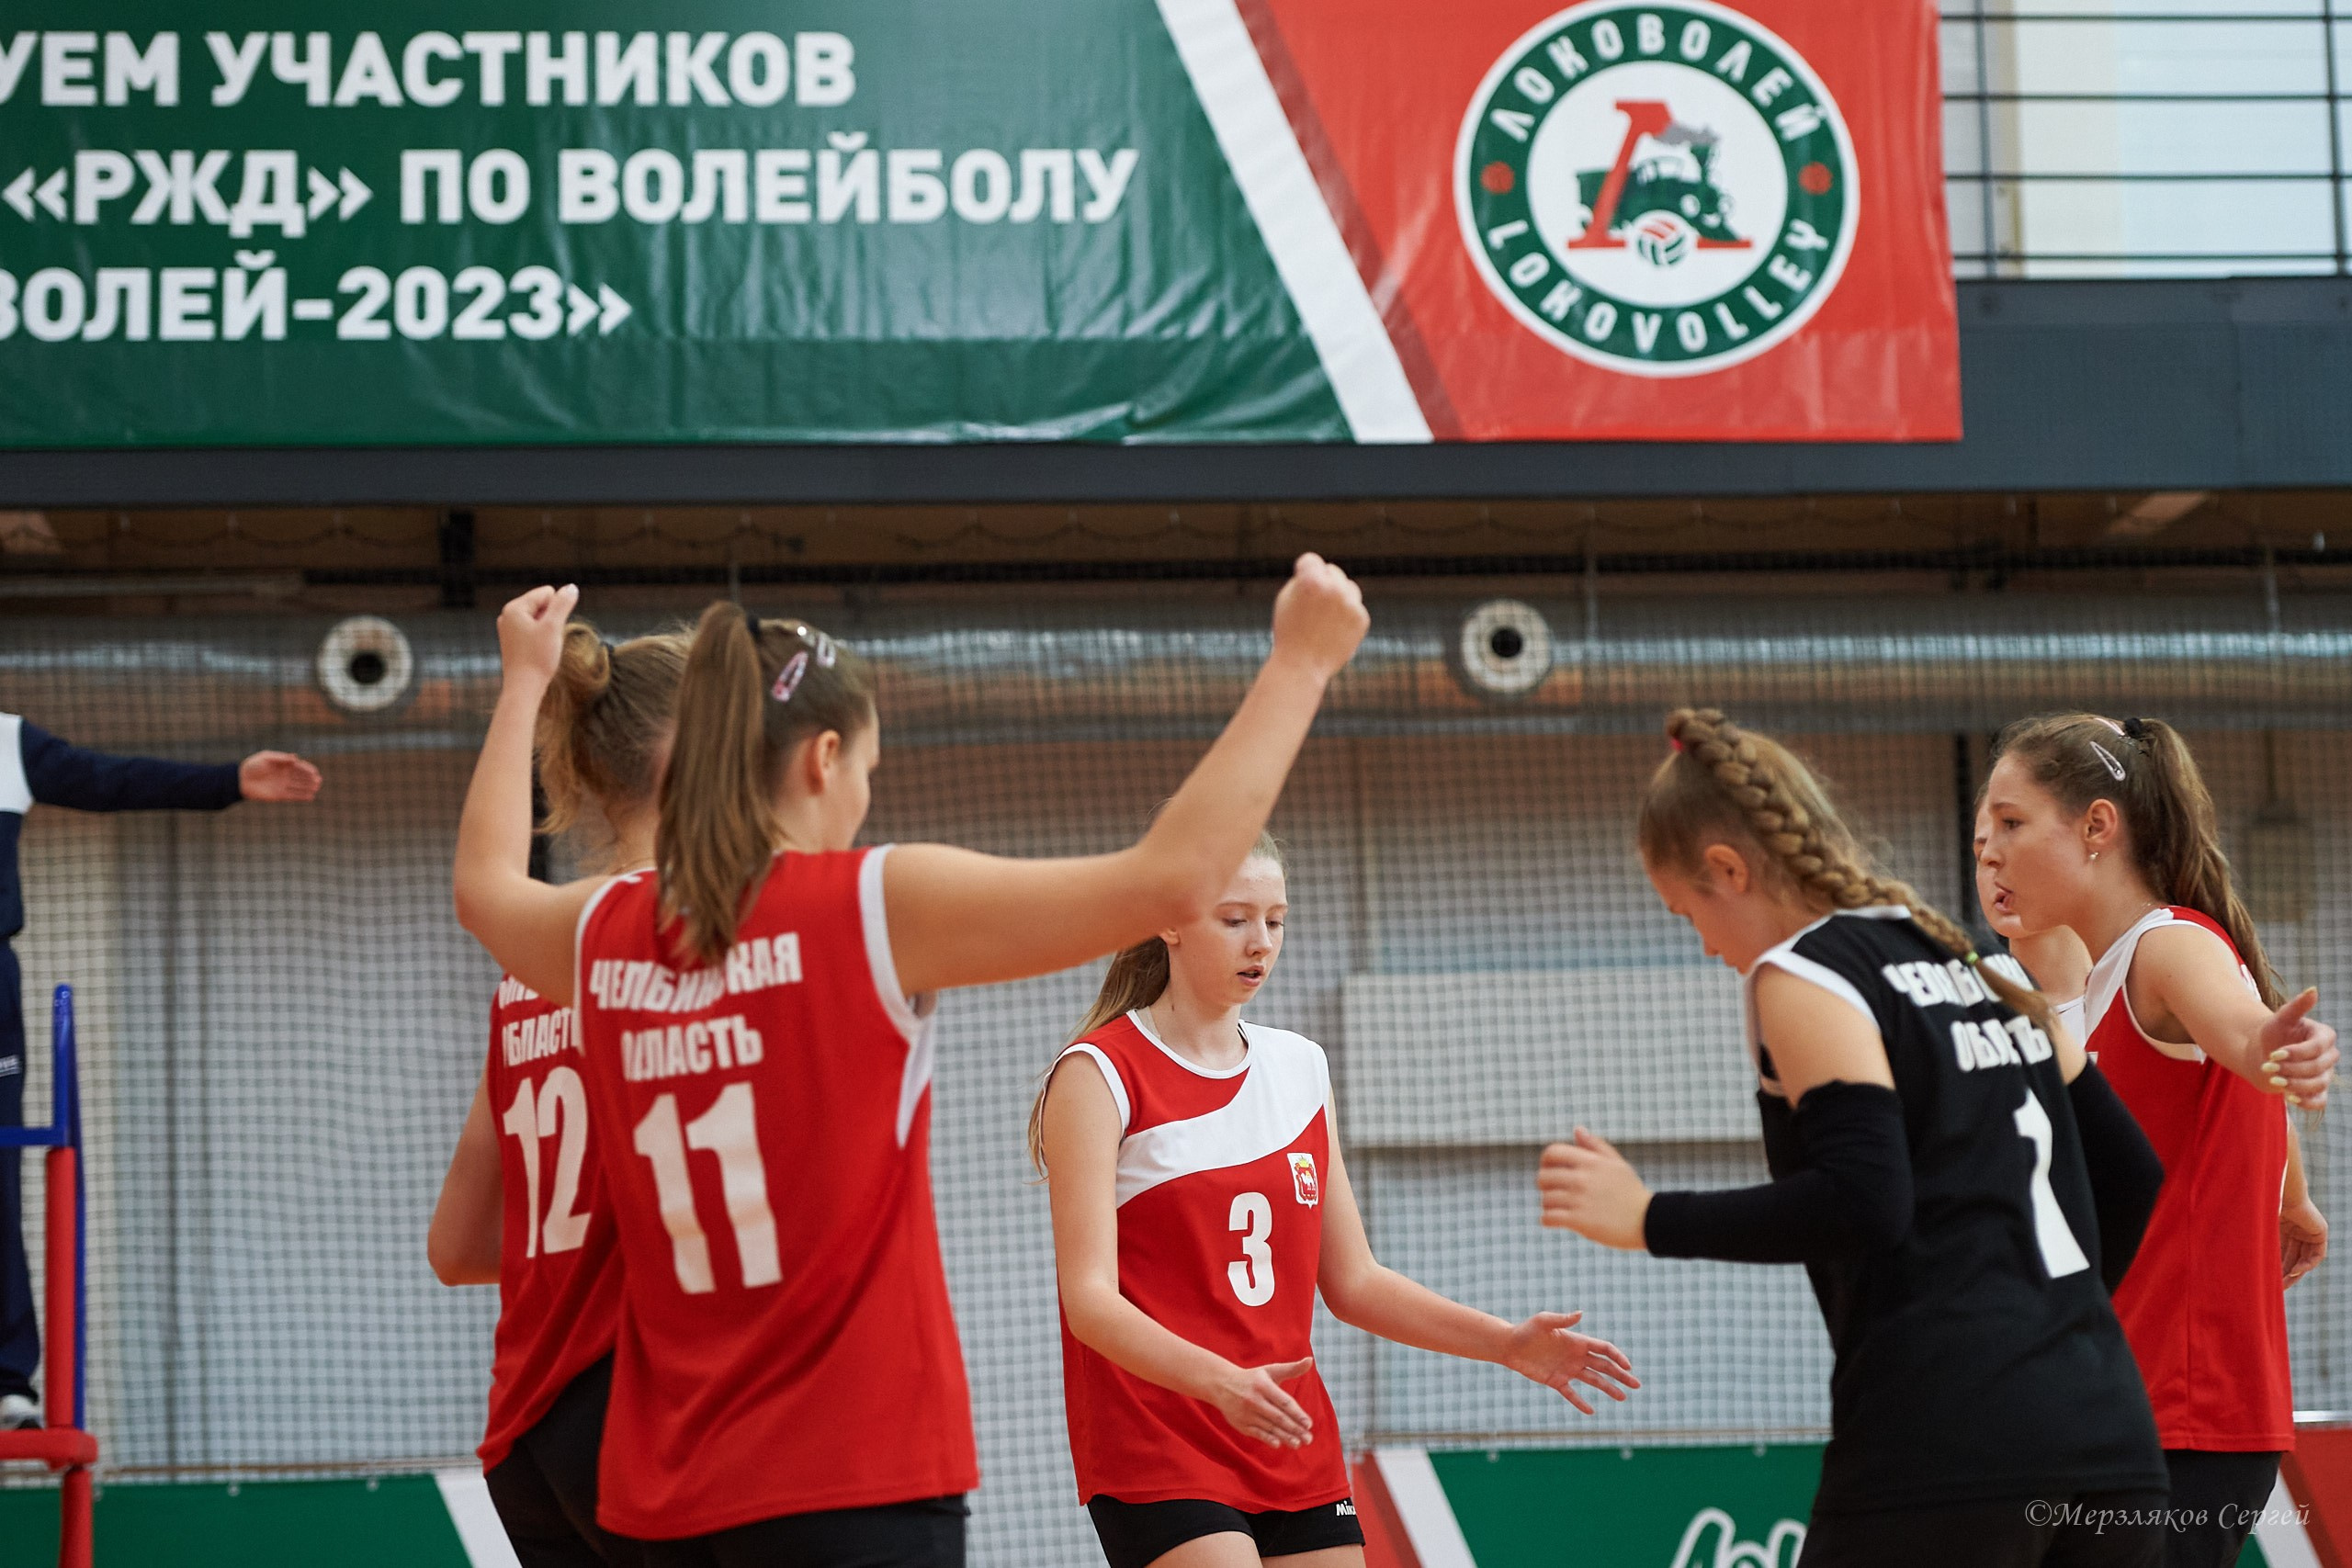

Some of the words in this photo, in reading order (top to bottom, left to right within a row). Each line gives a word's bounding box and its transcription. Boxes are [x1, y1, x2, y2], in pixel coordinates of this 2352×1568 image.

[205, 30, 857, 107] УЧАСТНИКОВ
[1490, 14, 1828, 141] ЛОКОВОЛЕЙ
[1, 149, 372, 239] «РЖД»
[400, 149, 531, 224] ПО
[558, 131, 1140, 224] ВОЛЕЙБОЛУ
[1488, 218, 1828, 353] LOKOVOLLEY
[503, 1066, 591, 1258] 12
[633, 1081, 783, 1293] 11
[2013, 1088, 2090, 1279] 1
[1227, 1191, 1275, 1306] 3
